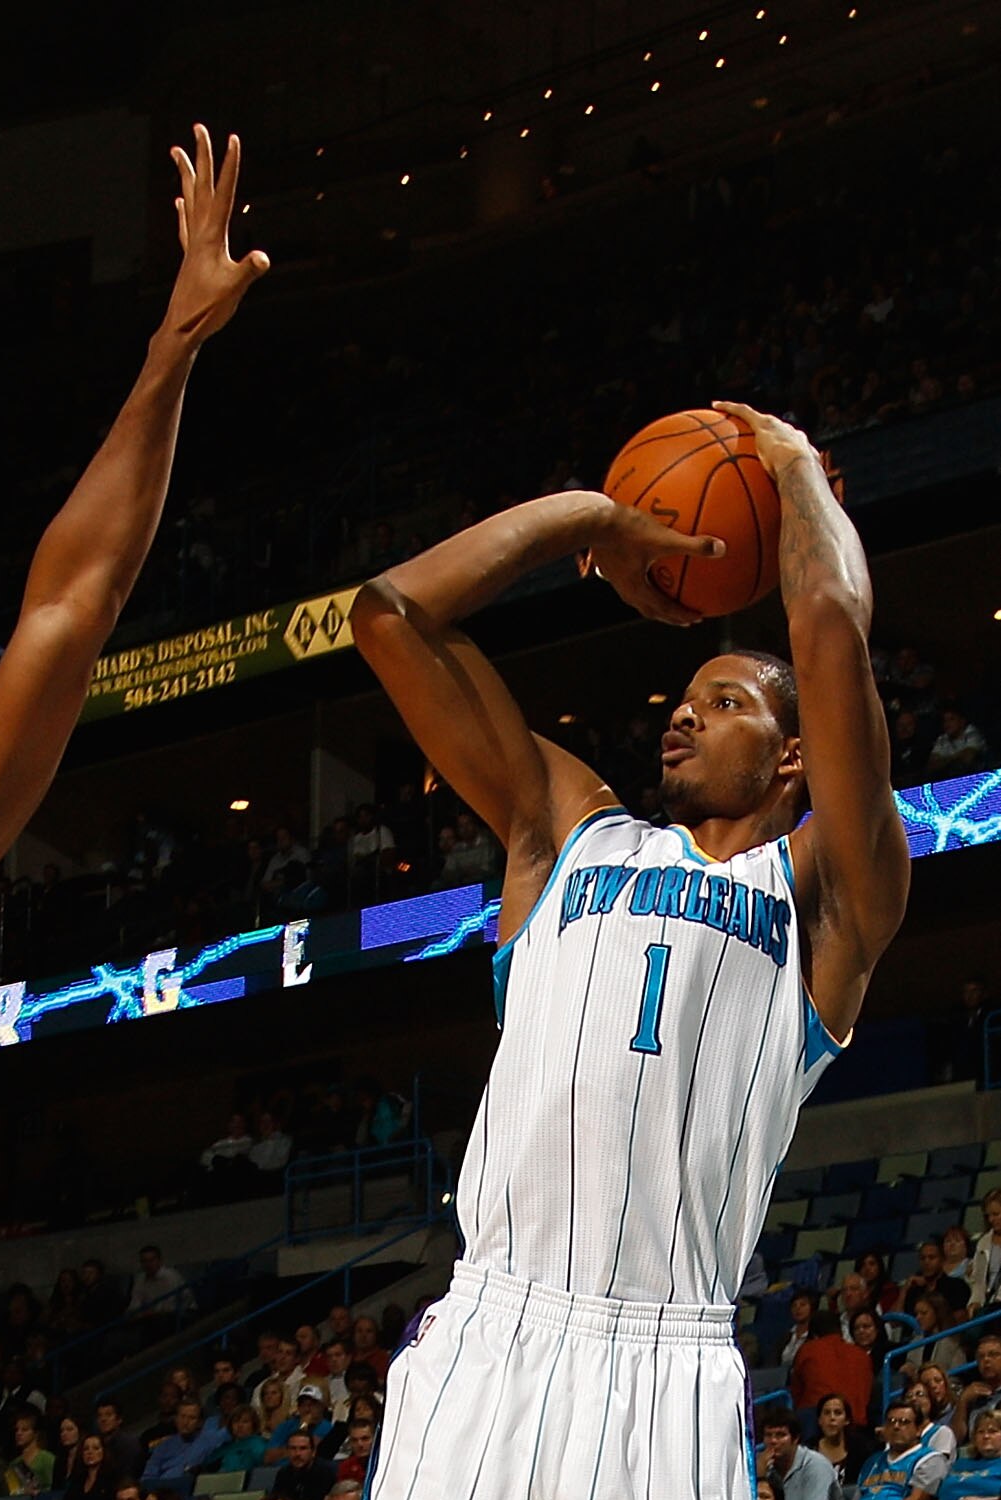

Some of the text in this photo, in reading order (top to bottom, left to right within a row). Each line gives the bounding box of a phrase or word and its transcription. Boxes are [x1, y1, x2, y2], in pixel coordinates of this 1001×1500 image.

[91, 644, 155, 680] HARD'S
[244, 608, 279, 638] INC.
[124, 661, 237, 712] 504-241-2142
[559, 864, 792, 968] NEW ORLEANS
[629, 943, 672, 1056] 1
